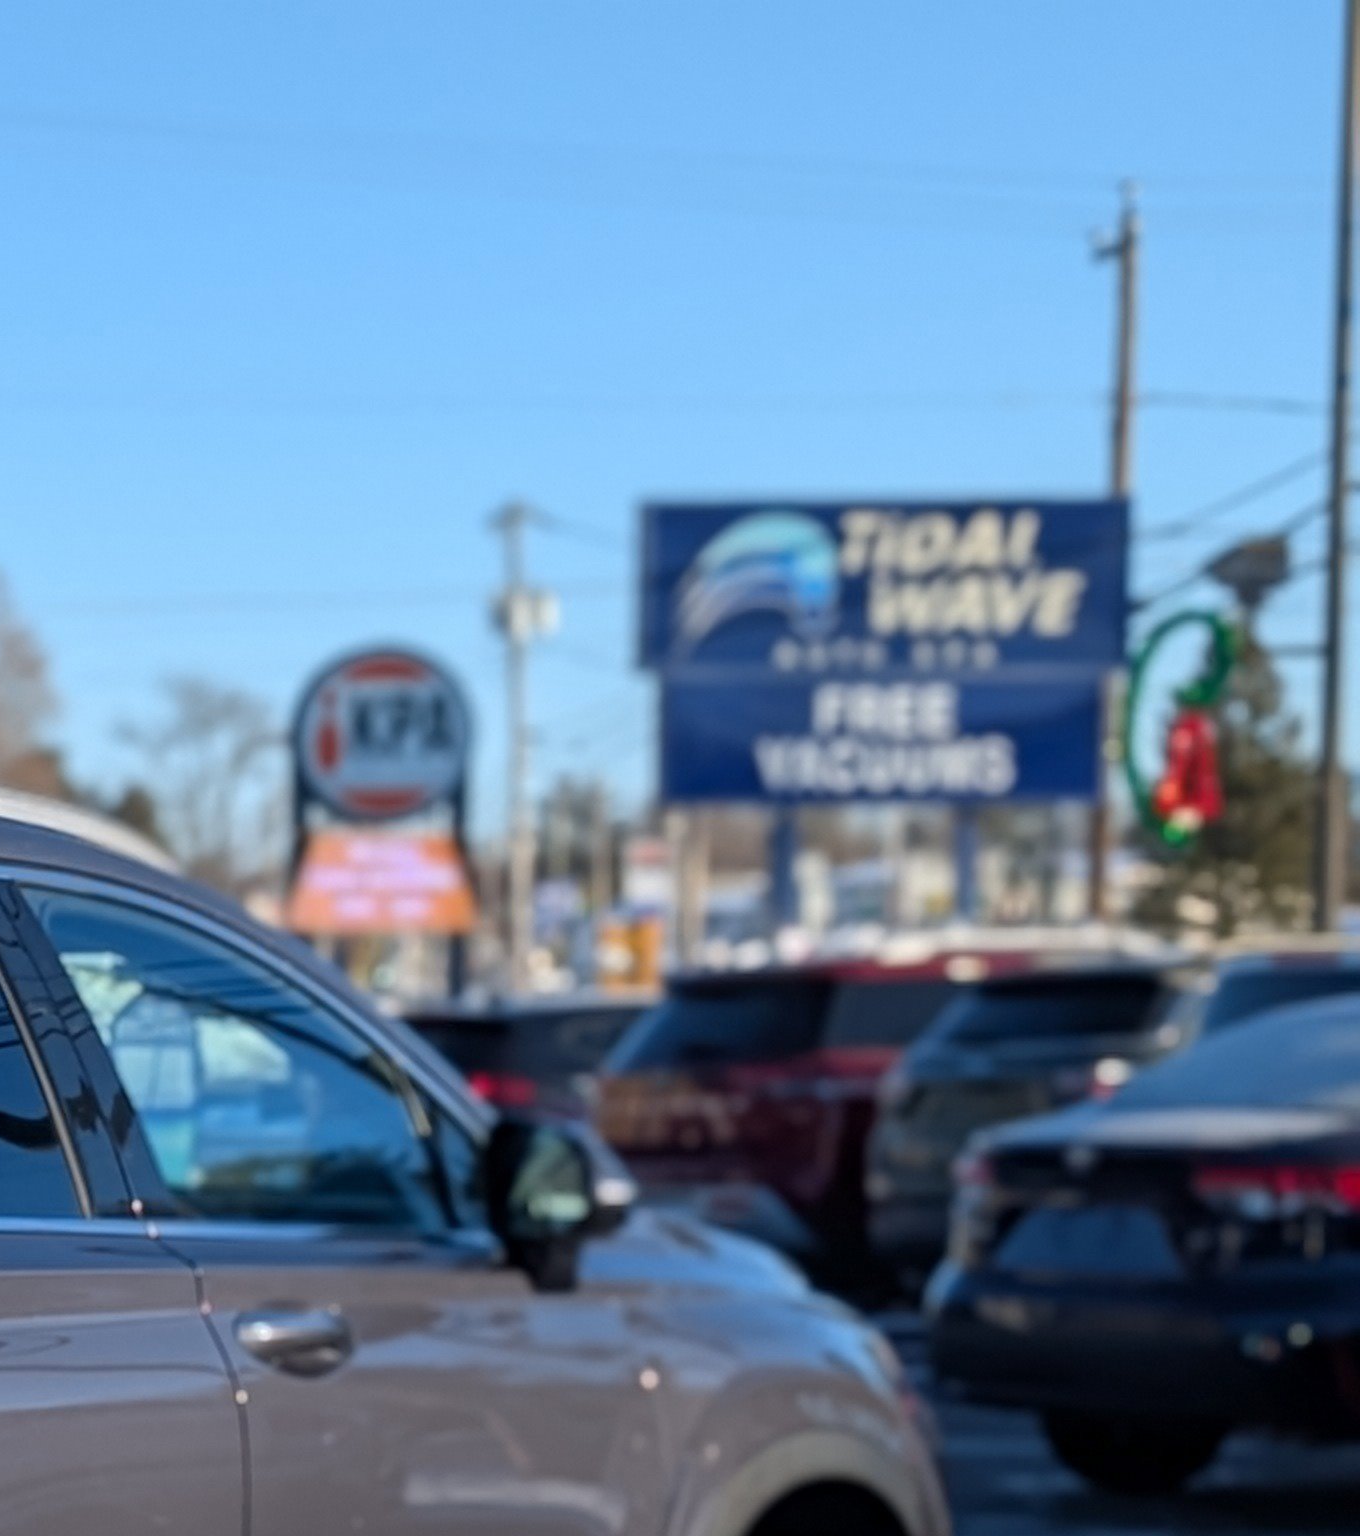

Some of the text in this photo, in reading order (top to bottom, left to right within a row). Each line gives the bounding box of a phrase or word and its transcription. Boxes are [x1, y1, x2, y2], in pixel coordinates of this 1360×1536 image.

[866, 570, 1087, 637] WAVE
[812, 682, 958, 737] FREE
[754, 734, 1018, 796] VACUUMS
